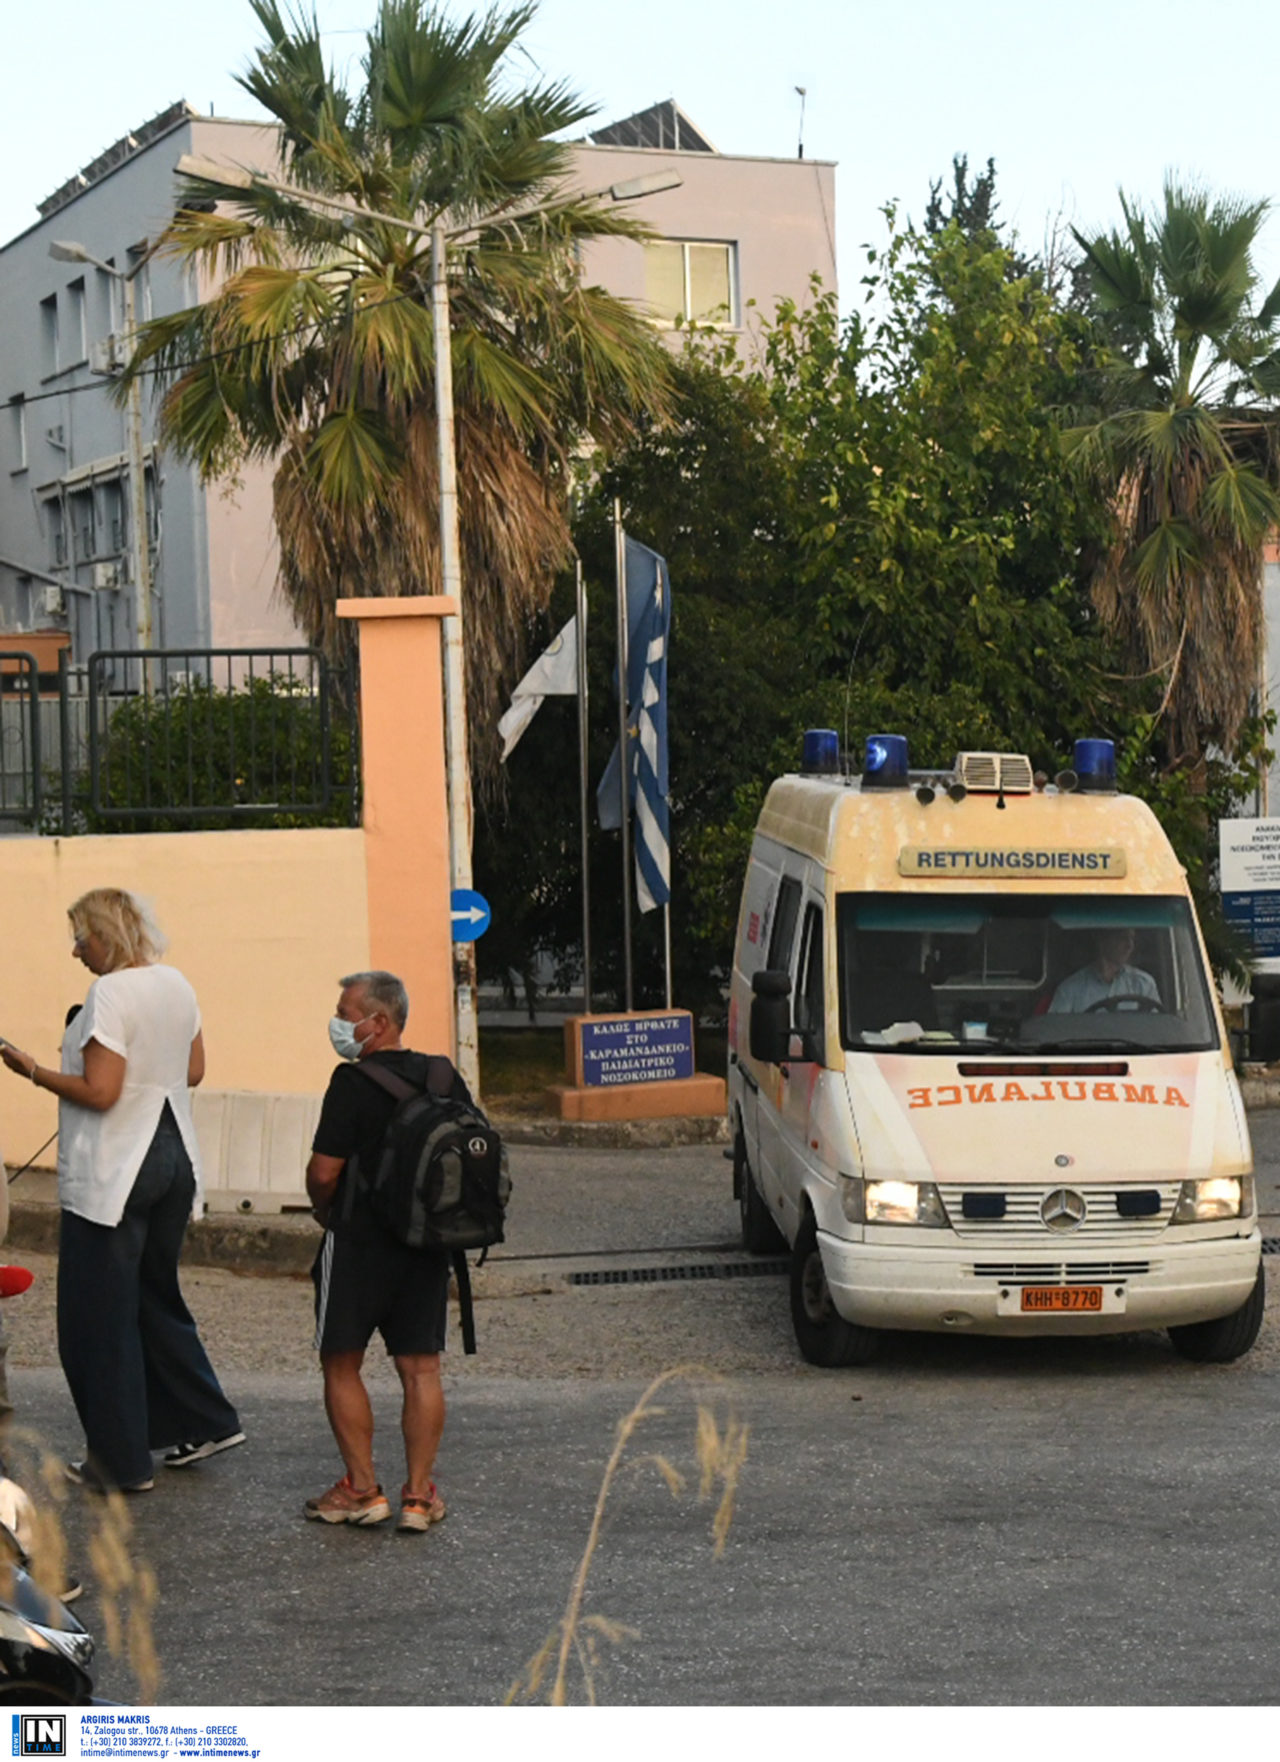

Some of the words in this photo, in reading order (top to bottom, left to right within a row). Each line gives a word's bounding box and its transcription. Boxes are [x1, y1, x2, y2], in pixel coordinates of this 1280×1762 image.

[917, 851, 1111, 870] RETTUNGSDIENST
[593, 1022, 630, 1035] ΚΑΛΩΣ
[626, 1034, 648, 1045] ΣΤΟ
[601, 1056, 675, 1072] ΠΑΙΔΙΑΤΡΙΚΟ
[600, 1068, 676, 1084] ΝΟΣΟΚΟΜΕΙΟ
